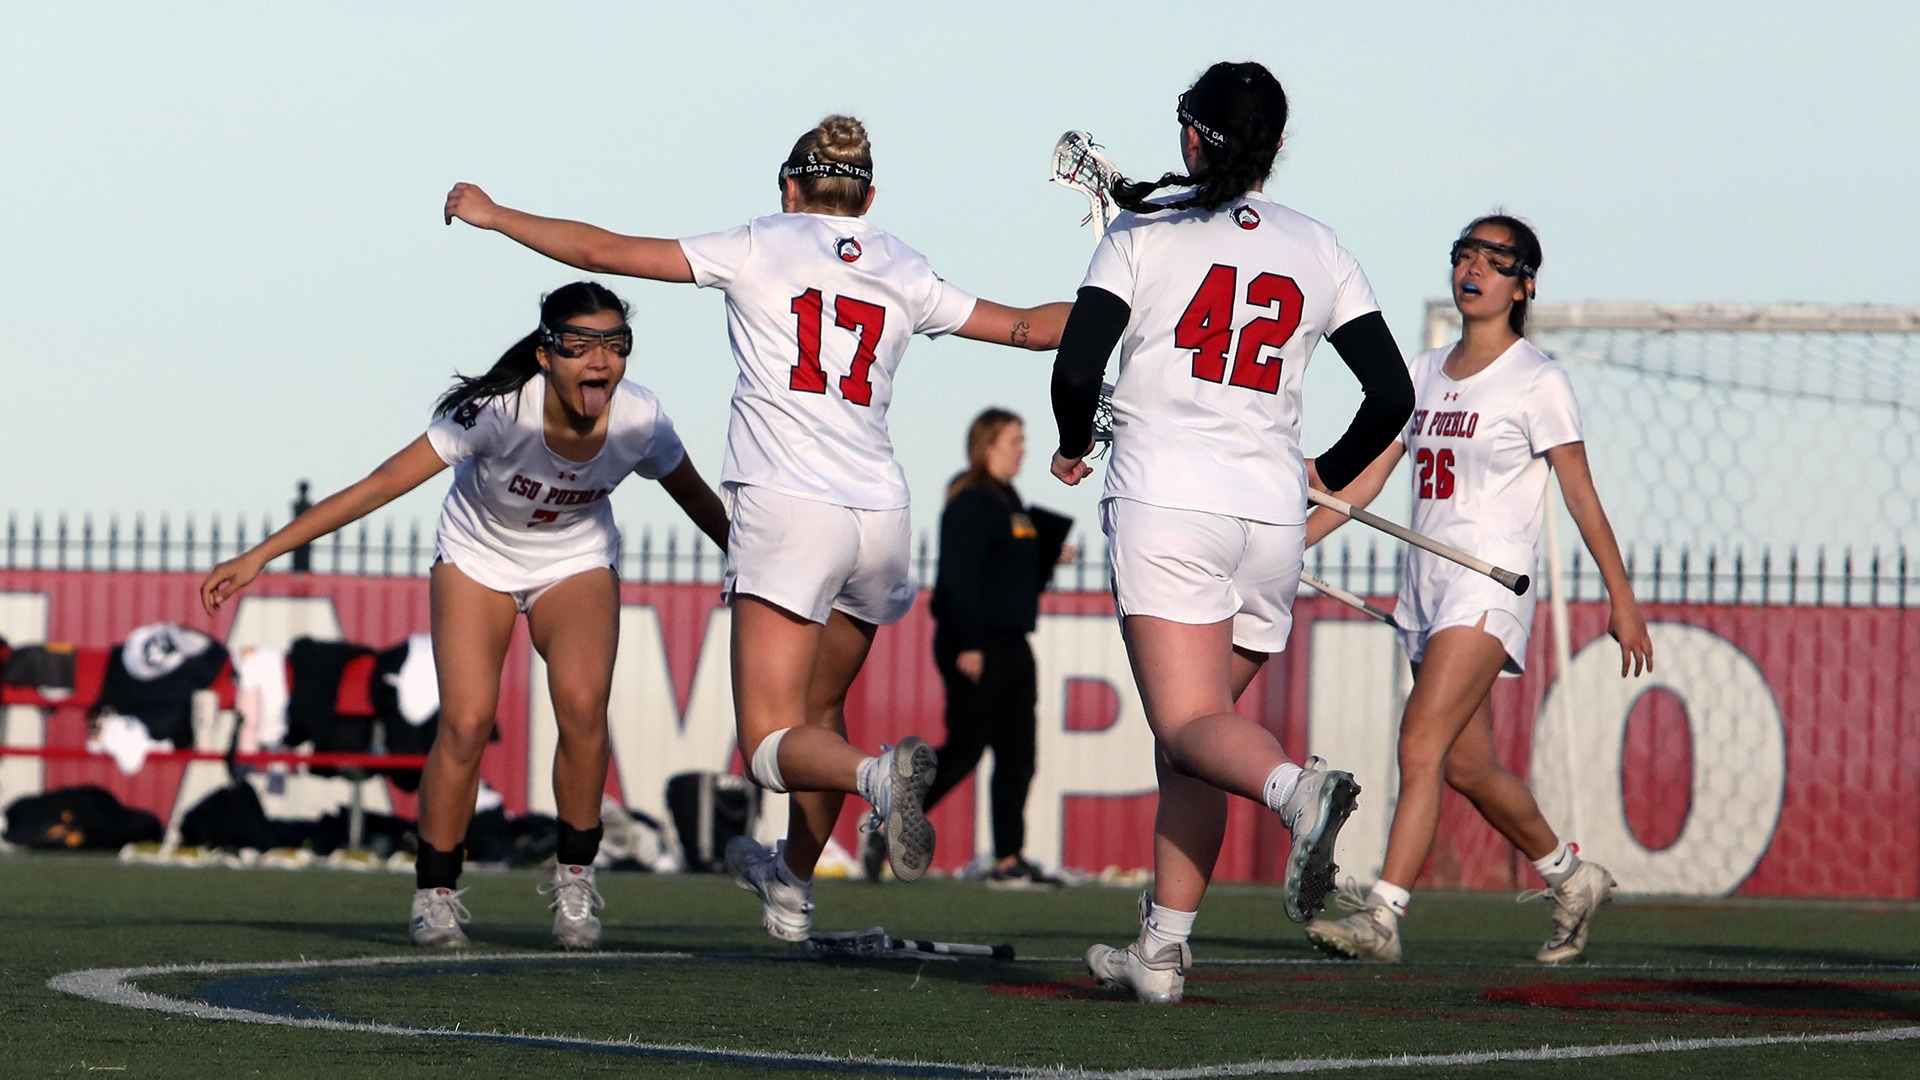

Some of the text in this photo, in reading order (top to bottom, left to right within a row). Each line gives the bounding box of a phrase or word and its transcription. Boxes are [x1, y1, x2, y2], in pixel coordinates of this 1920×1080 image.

[1193, 119, 1210, 134] GAIT
[806, 164, 831, 173] GAIT
[1174, 263, 1305, 395] 42
[789, 287, 886, 407] 17
[1410, 409, 1479, 438] SU PUEBLO
[508, 473, 543, 501] CSU
[1416, 447, 1455, 500] 26
